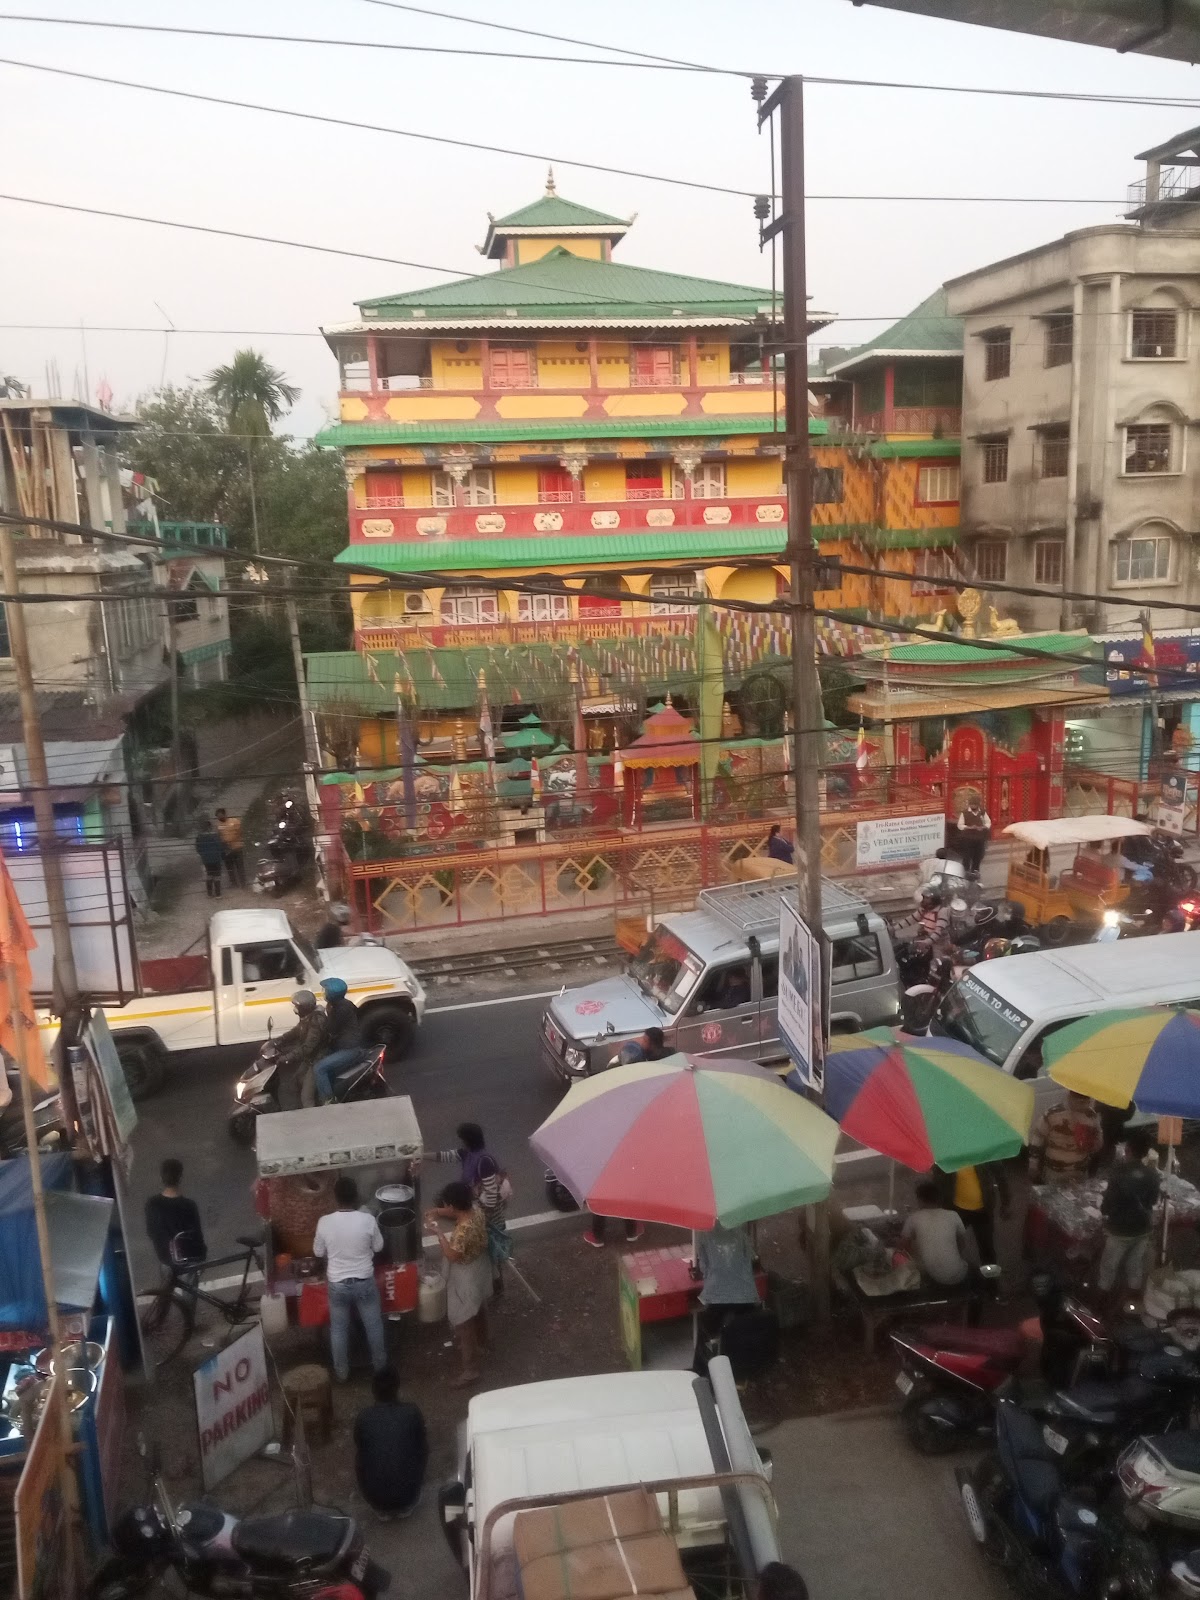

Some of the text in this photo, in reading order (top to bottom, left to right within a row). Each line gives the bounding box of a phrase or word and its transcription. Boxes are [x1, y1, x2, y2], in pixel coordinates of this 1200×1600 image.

[873, 836, 902, 847] VEDANT
[905, 832, 941, 843] INSTITUTE
[900, 817, 926, 827] Computer
[965, 979, 1021, 1024] SUKNA TO NJP
[212, 1356, 251, 1401] NO
[201, 1382, 269, 1456] PARKING
